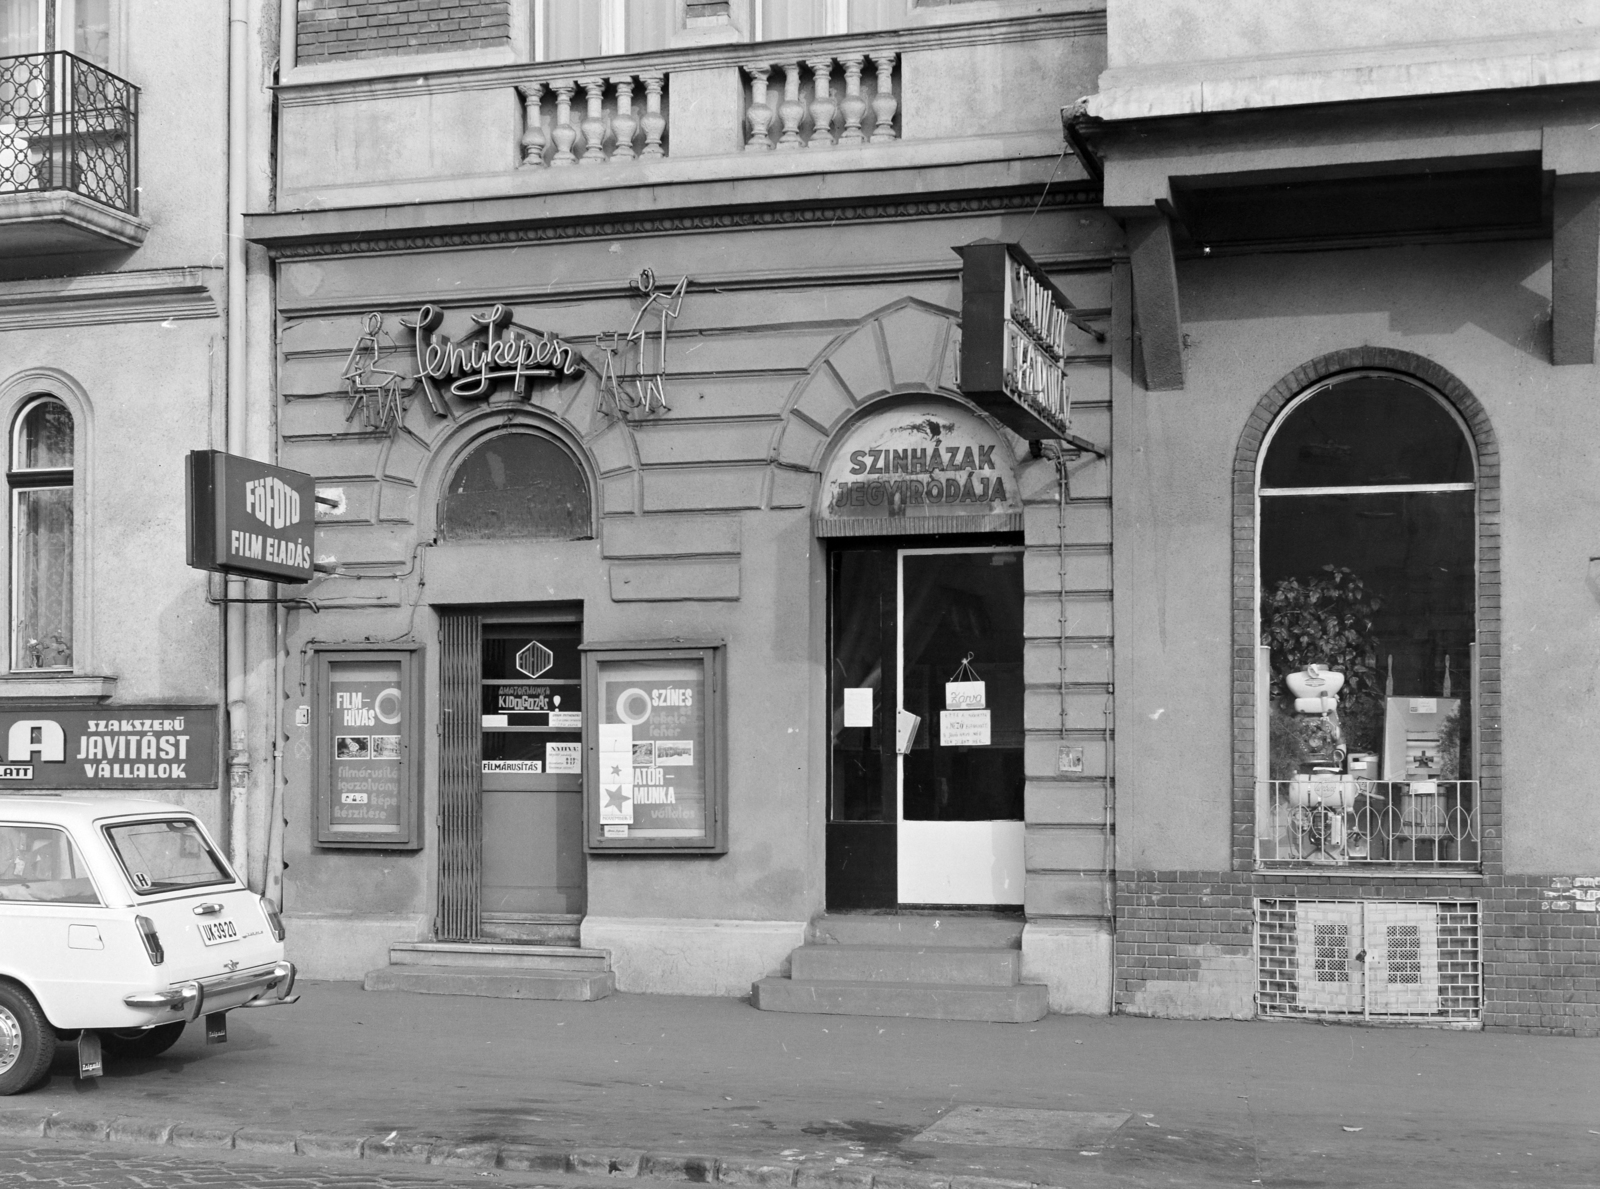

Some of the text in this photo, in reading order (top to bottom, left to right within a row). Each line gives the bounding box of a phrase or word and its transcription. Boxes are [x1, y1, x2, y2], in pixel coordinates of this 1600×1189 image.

[849, 439, 996, 475] SZINHÁZAK
[835, 471, 1007, 508] JEGYIRODÁJA
[231, 530, 311, 570] FILM ELADÁS
[651, 685, 693, 707] SZÍNES
[950, 691, 983, 704] Zárva
[87, 716, 185, 732] SZAKSZERŰ
[343, 706, 375, 726] HÍVÁS
[77, 732, 190, 760] JAVITÁST
[84, 760, 187, 779] VÁLLALOK
[633, 787, 676, 804] MUNKA
[135, 873, 149, 887] H
